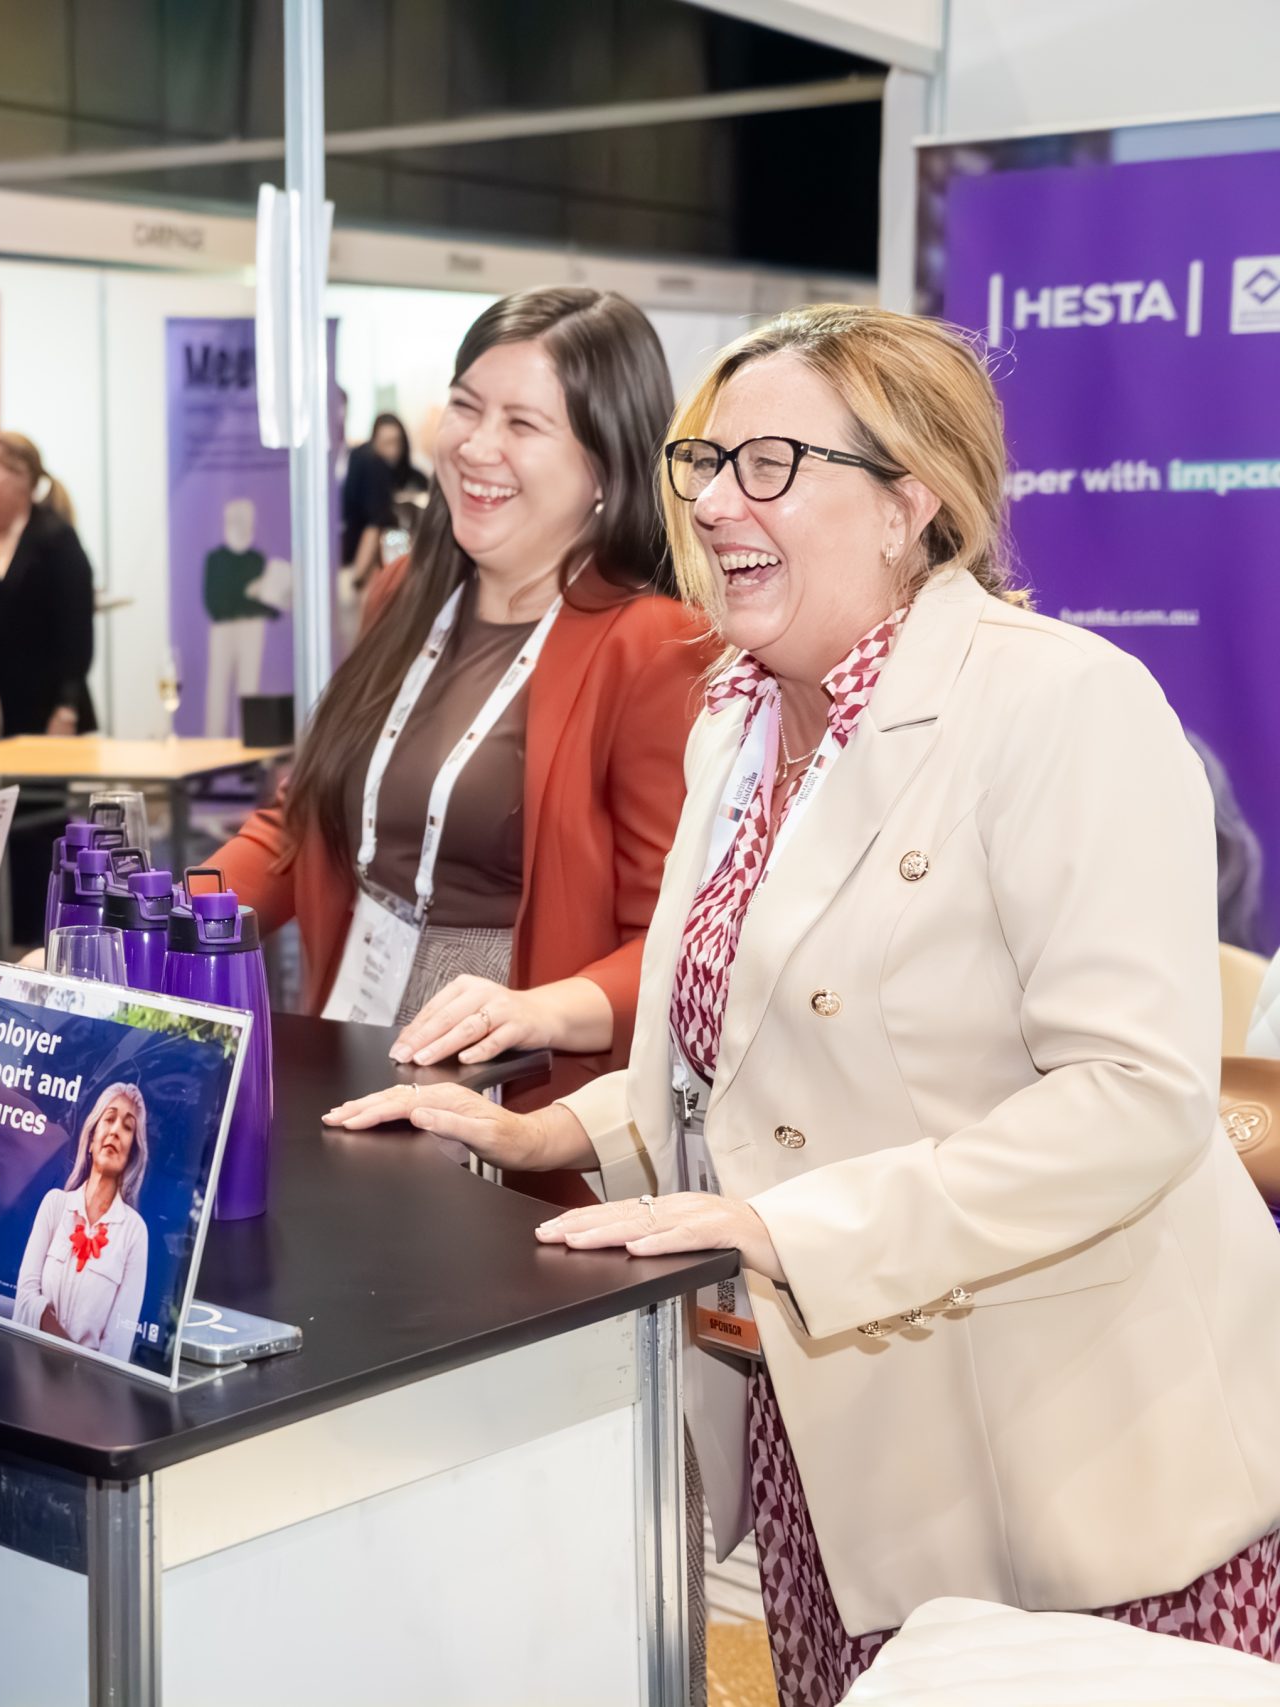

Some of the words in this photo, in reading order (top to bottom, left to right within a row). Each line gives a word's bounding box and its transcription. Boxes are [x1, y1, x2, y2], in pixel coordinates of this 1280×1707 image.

[1014, 278, 1178, 330] HESTA
[1081, 459, 1162, 493] with
[737, 771, 759, 806] Australia
[37, 1072, 83, 1103] and
[709, 1317, 742, 1337] SPONSOR
